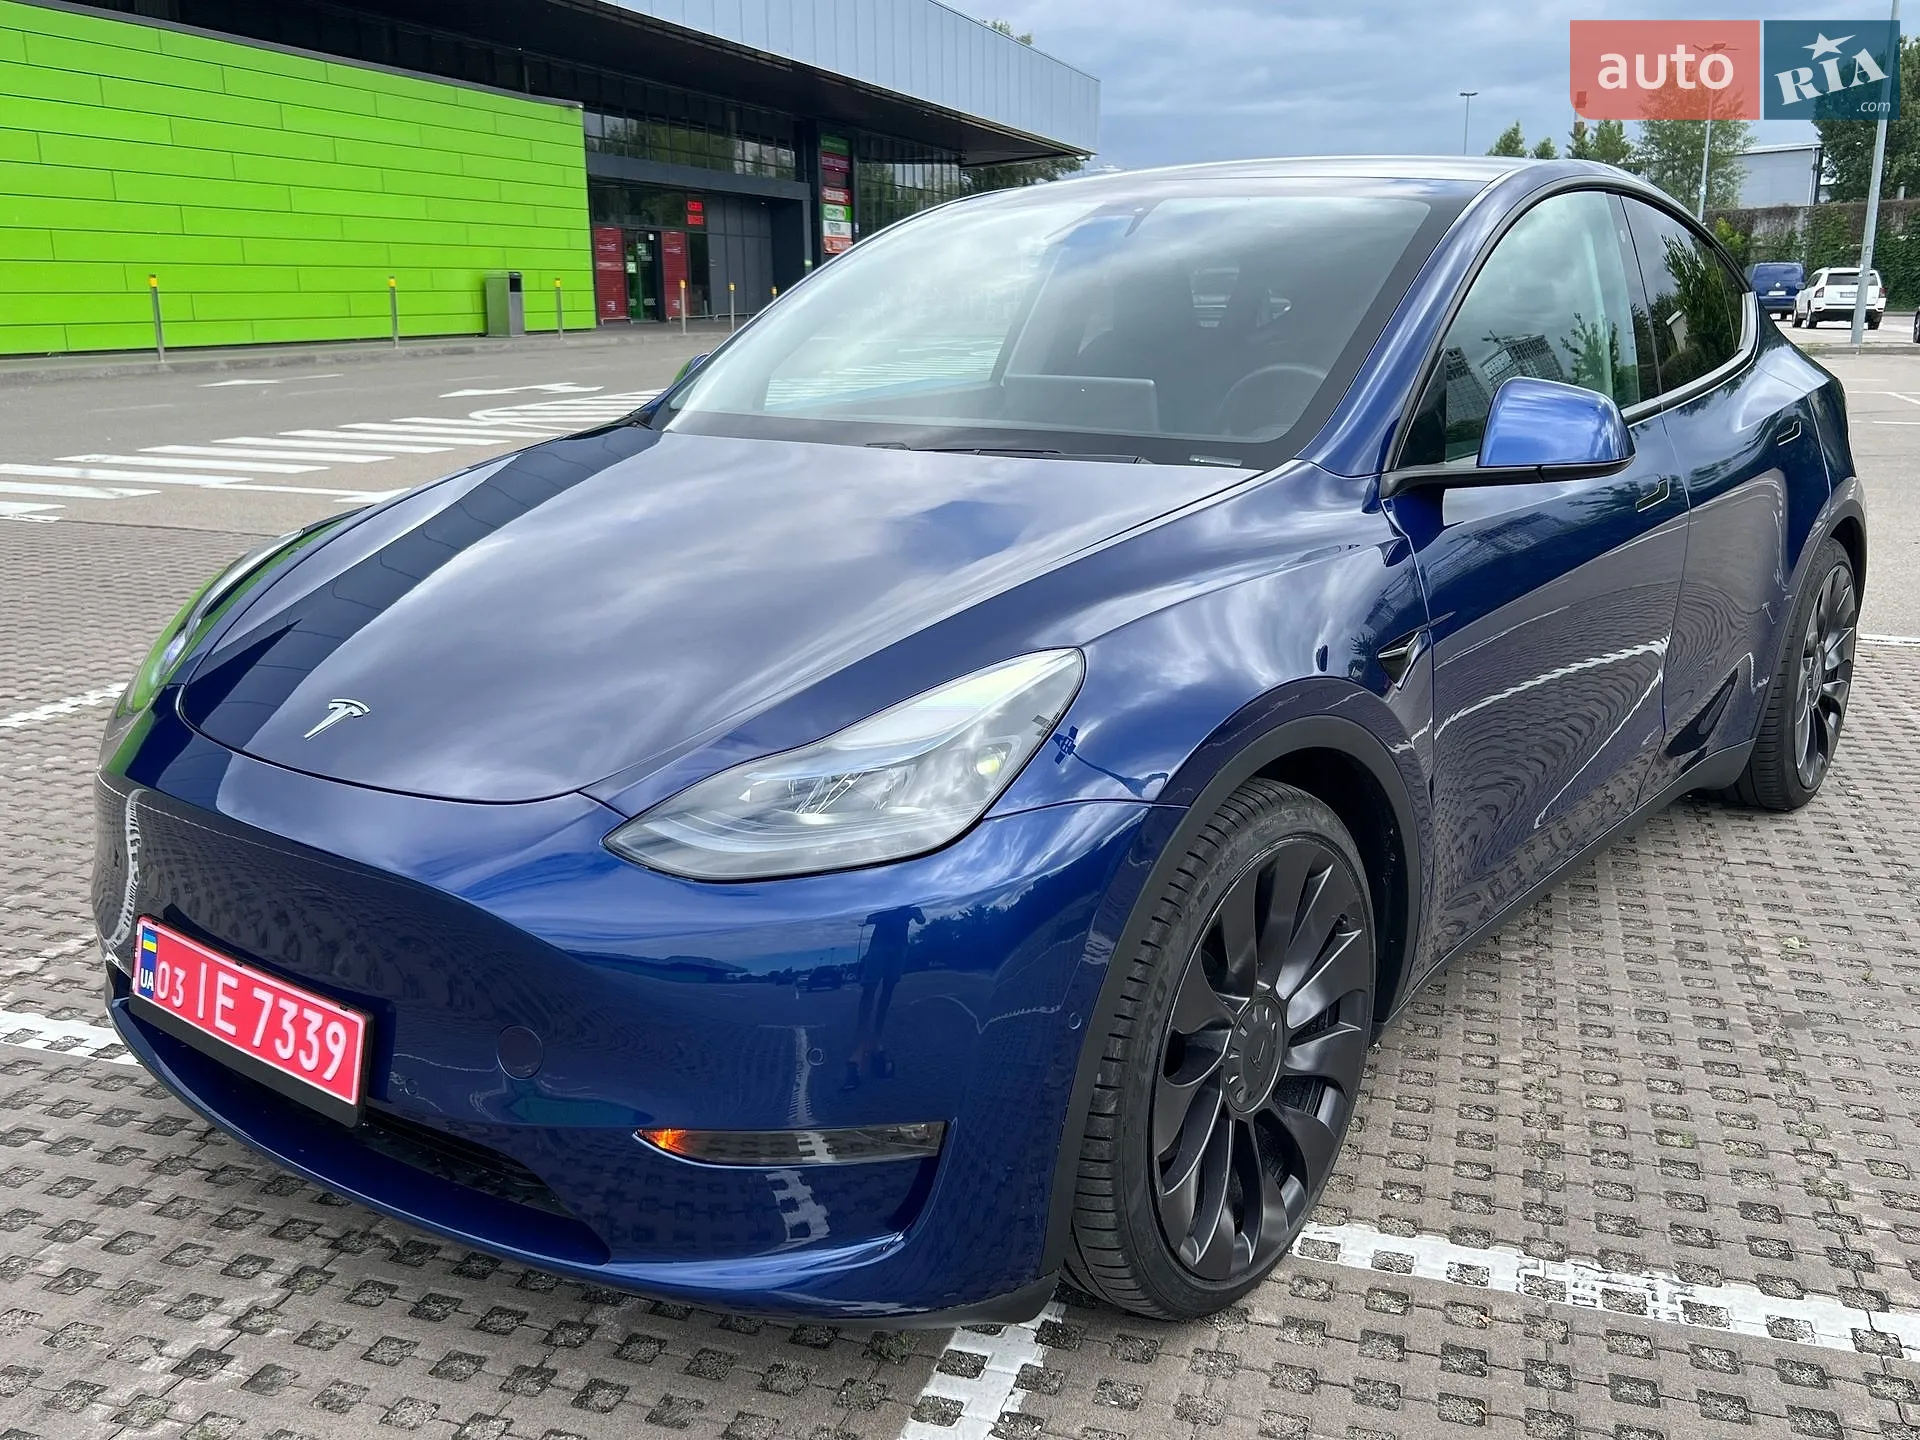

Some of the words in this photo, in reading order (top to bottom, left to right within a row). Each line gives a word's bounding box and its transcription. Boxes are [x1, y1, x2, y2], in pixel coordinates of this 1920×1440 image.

[140, 967, 155, 992] UA
[156, 960, 187, 1008] 03
[197, 961, 239, 1036] IE
[252, 986, 347, 1081] 7339
